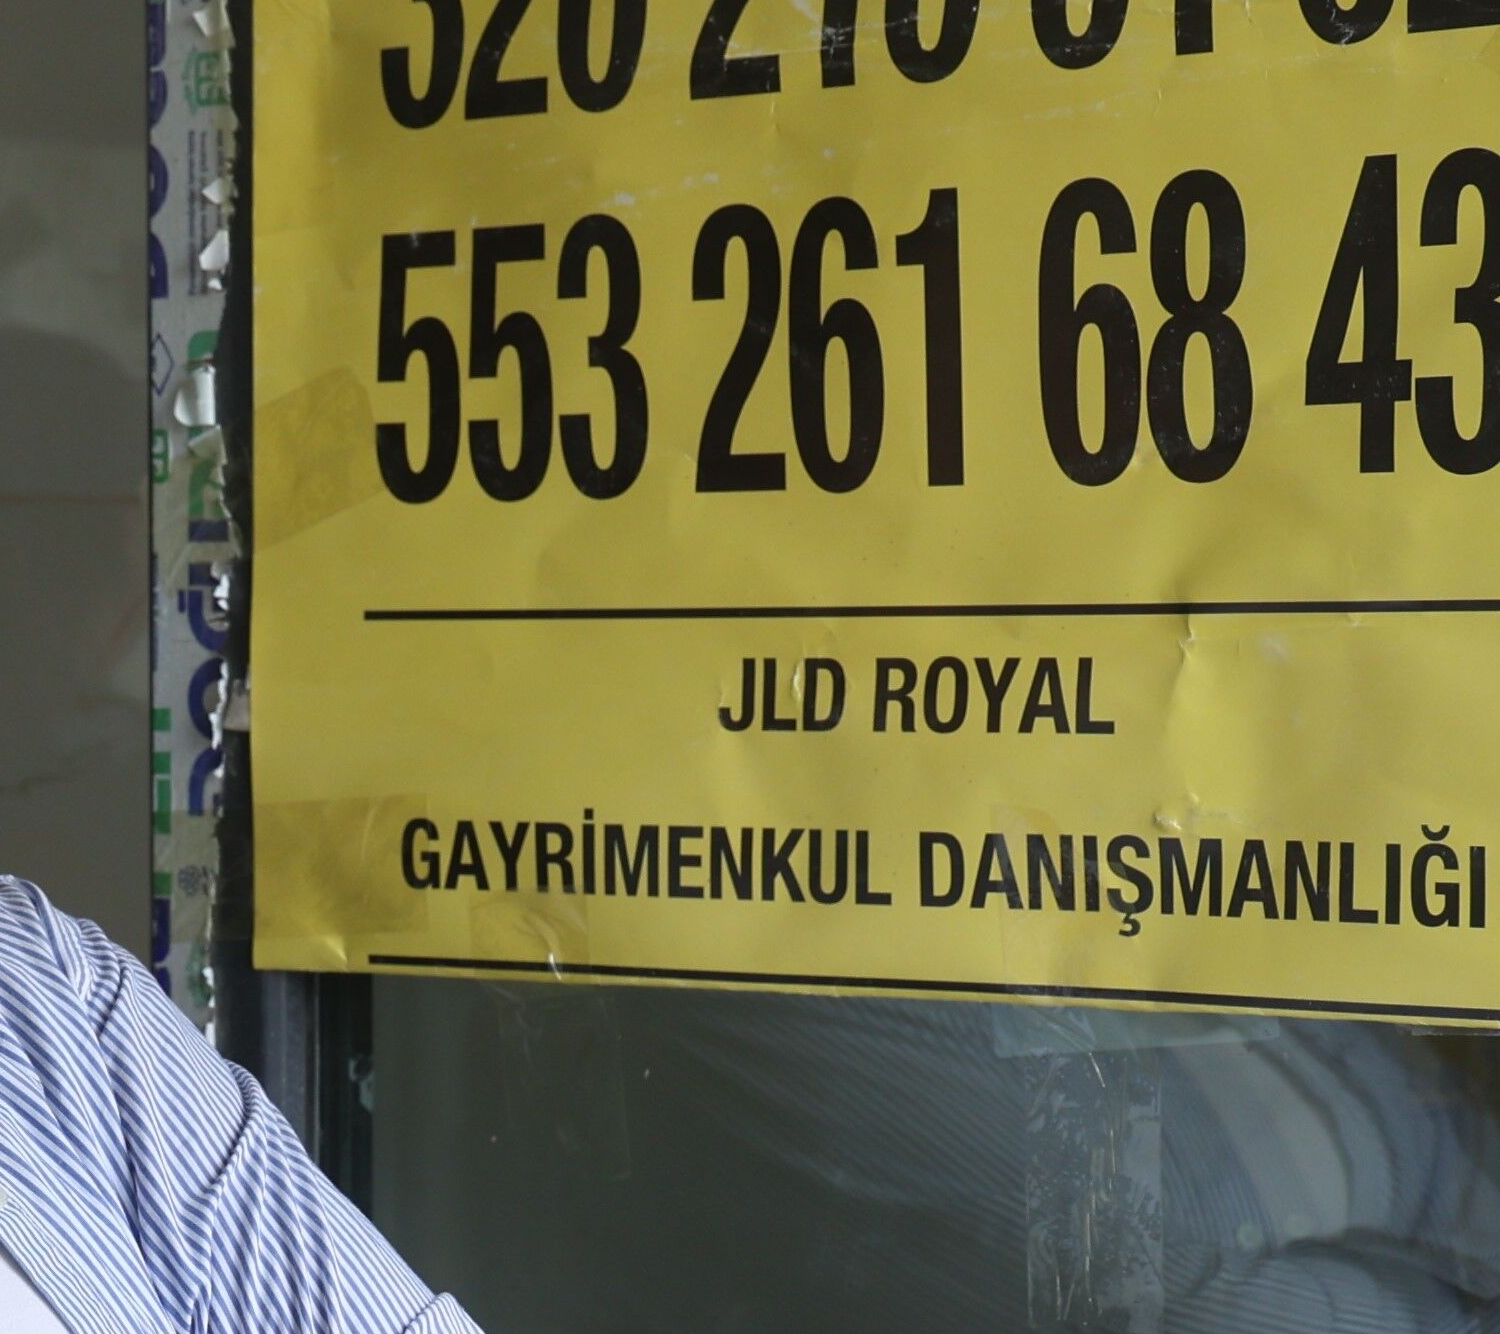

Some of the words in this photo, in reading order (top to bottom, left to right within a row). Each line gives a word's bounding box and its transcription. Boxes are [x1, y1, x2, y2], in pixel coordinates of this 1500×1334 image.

[376, 214, 648, 504] 553
[692, 188, 963, 493] 261
[1039, 170, 1252, 486] 68
[719, 658, 845, 731] JLD
[873, 657, 1114, 734] ROYAL
[401, 809, 891, 906] GAYRİMENKUL
[920, 825, 1485, 936] DANIŞMANLIĞI
